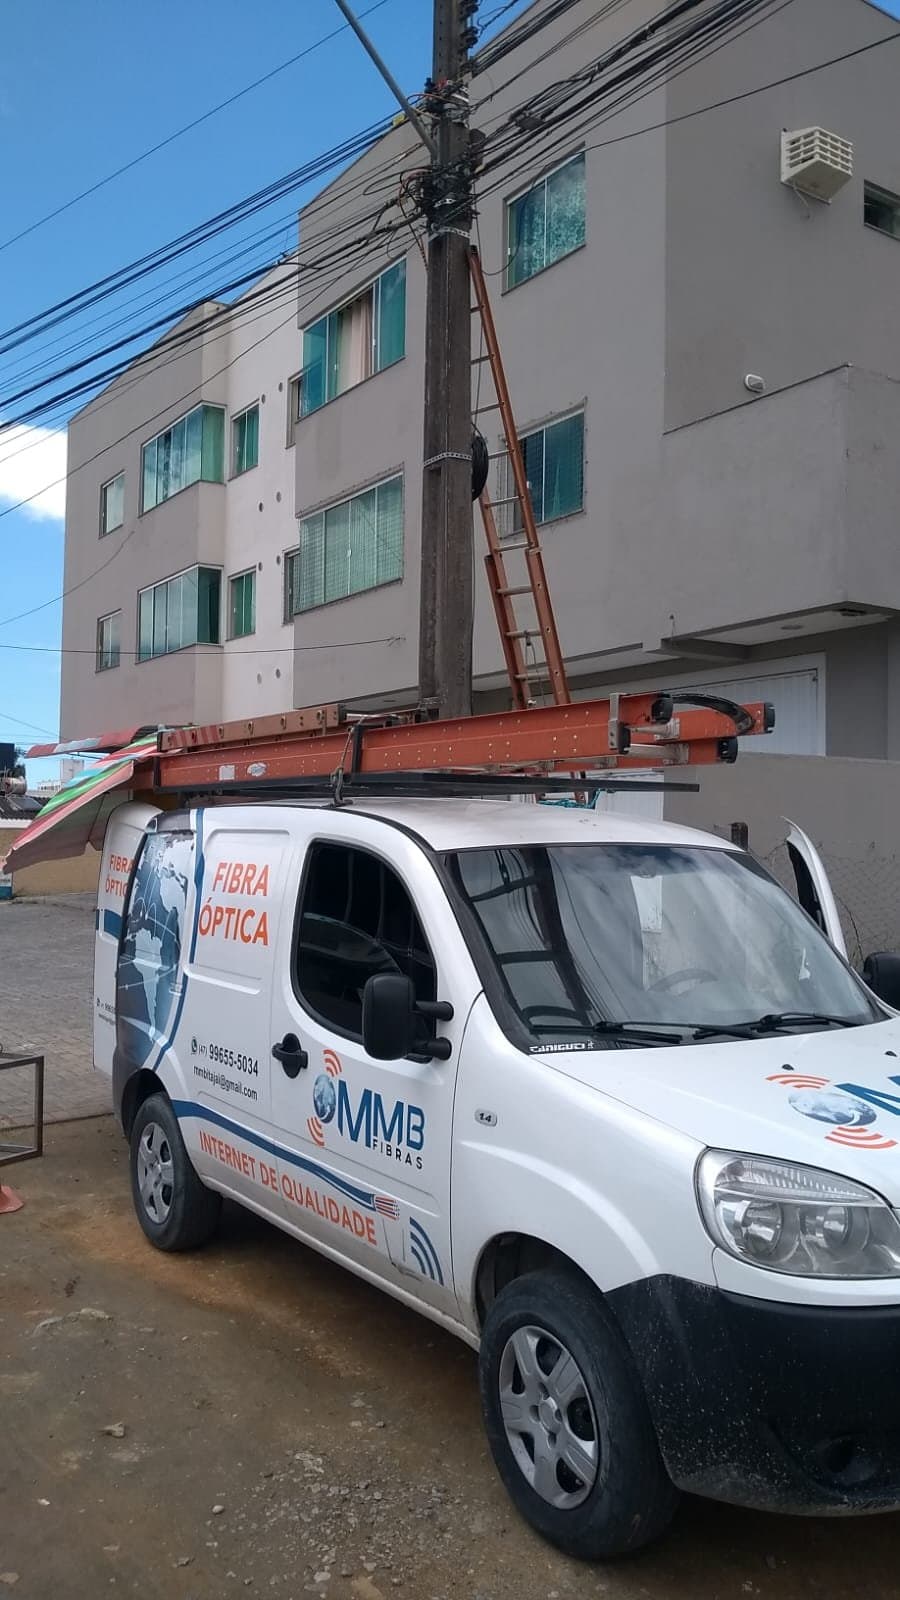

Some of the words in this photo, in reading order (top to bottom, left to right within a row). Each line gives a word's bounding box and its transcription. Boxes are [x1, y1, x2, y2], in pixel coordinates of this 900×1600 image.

[105, 873, 129, 897] ÓPTIC
[213, 862, 269, 896] FIBRA
[199, 897, 269, 946] ÓPTICA
[199, 1044, 208, 1057] (47)
[209, 1043, 259, 1077] 99655-5034
[193, 1065, 258, 1101] mmbitajai@gmail.com
[337, 1079, 425, 1151] MMB
[372, 1139, 423, 1170] FIBRAS
[199, 1130, 256, 1180] INTERNET
[259, 1161, 278, 1193] DE
[280, 1174, 377, 1246] QUALIDADE
